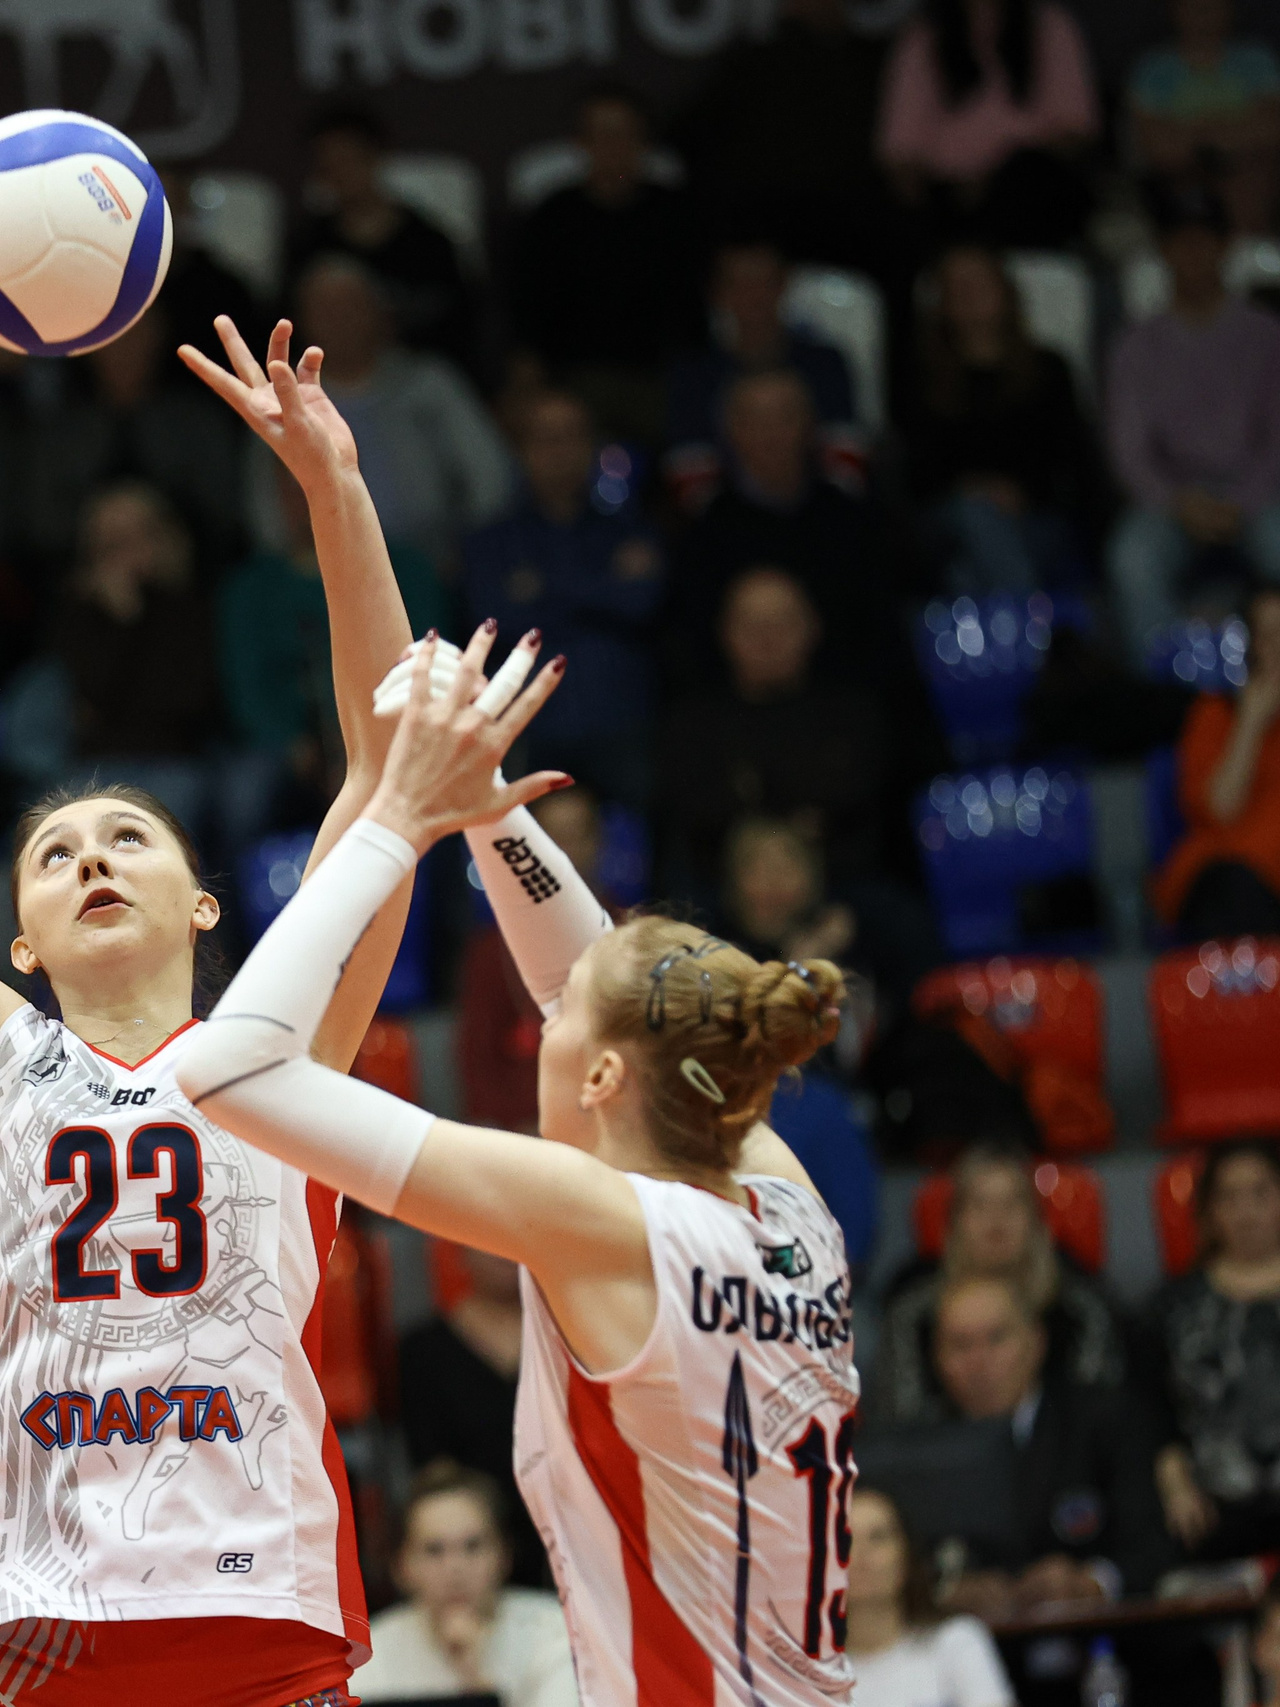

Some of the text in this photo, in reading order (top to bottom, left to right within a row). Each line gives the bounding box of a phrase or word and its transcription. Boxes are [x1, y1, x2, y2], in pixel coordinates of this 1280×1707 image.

[45, 1121, 208, 1303] 23
[20, 1385, 242, 1450] СПАРТА
[216, 1552, 254, 1573] GS
